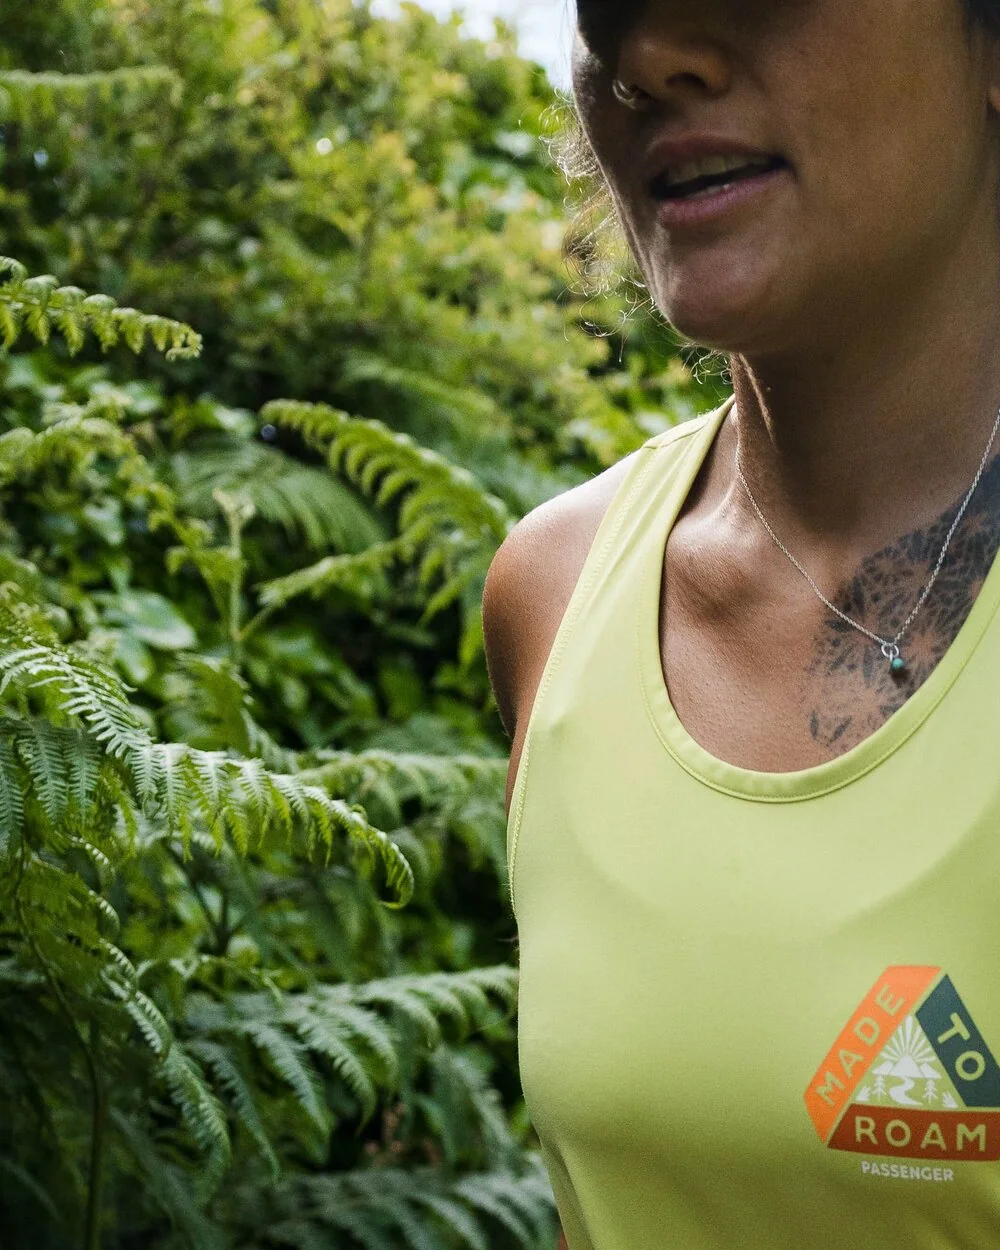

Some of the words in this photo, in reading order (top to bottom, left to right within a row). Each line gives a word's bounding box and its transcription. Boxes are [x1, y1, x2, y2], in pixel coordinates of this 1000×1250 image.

[815, 984, 905, 1106] MADE
[937, 1012, 986, 1082] TO
[855, 1116, 987, 1152] ROAM
[861, 1160, 954, 1182] PASSENGER
